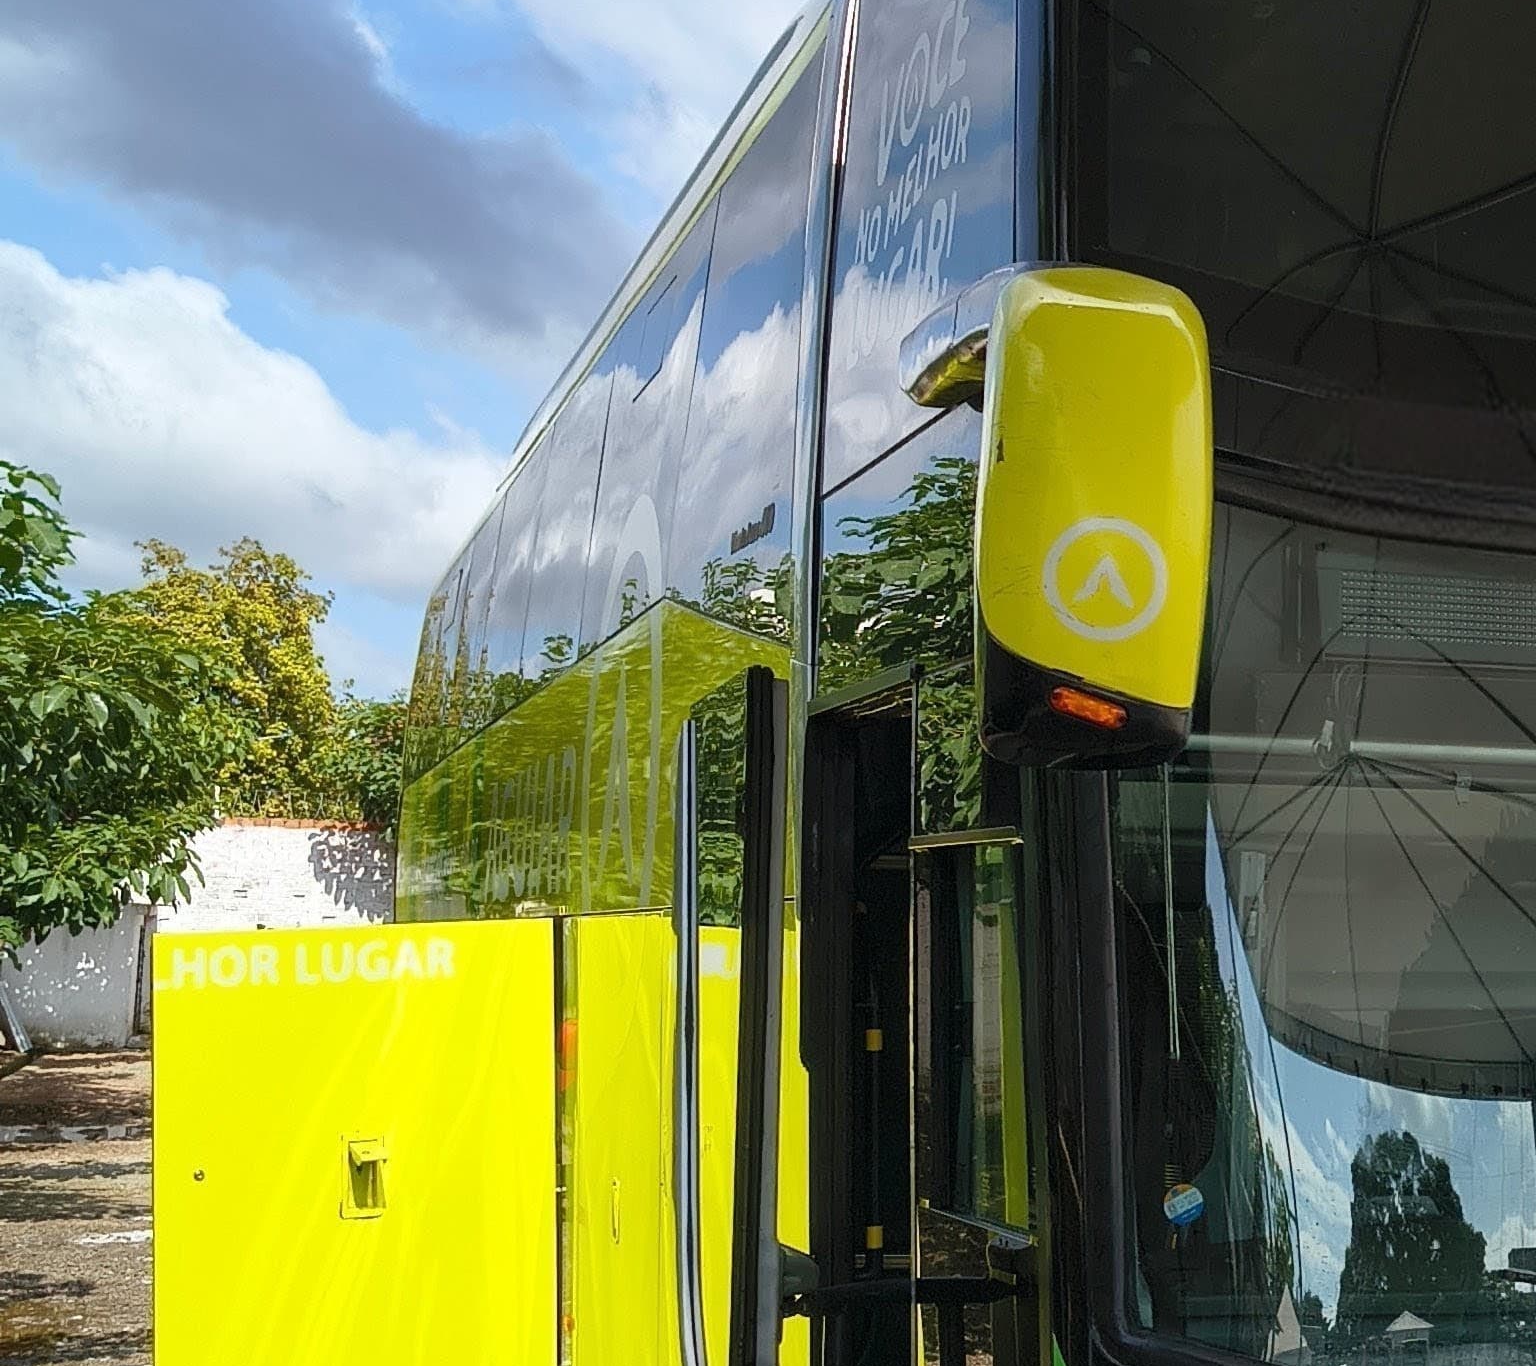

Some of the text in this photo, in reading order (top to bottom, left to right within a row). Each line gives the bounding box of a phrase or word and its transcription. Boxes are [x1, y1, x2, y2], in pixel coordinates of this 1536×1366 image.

[855, 95, 972, 265] NO MELHOR
[294, 937, 457, 985] LUGAR
